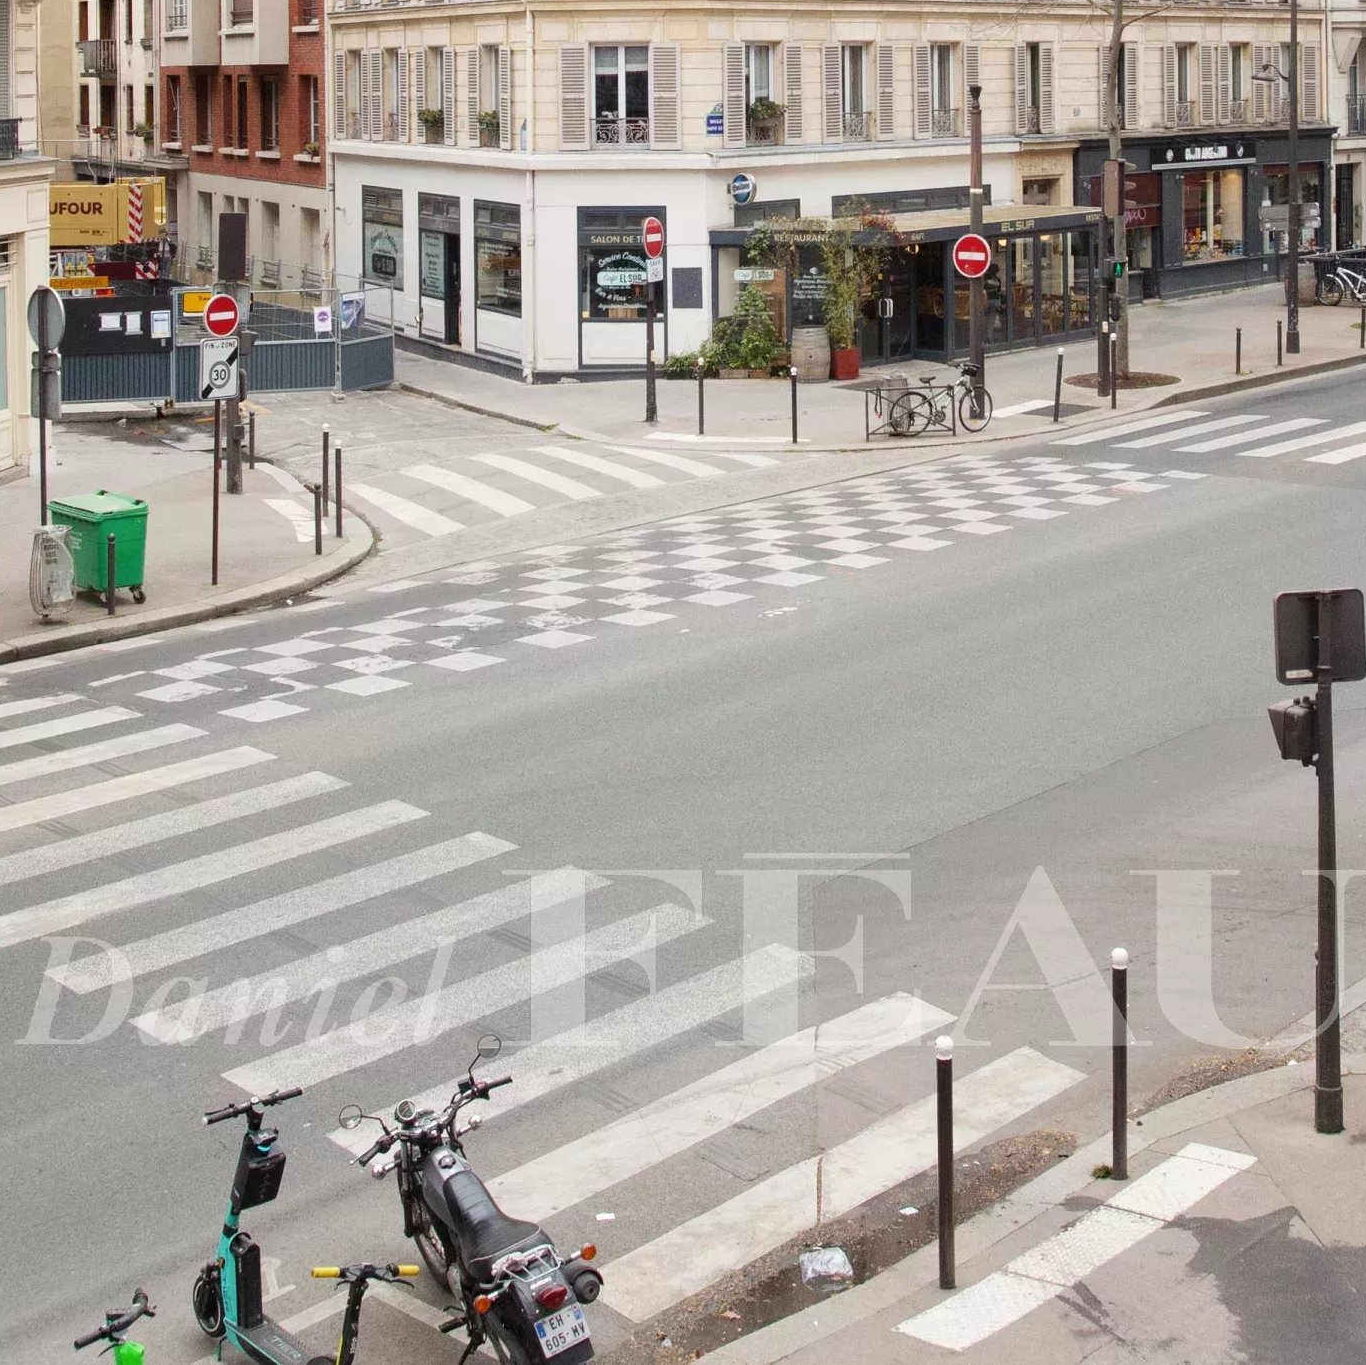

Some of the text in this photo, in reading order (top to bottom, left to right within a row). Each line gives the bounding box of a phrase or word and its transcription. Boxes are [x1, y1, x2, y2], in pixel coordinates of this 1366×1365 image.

[49, 202, 103, 215] UFOUR
[1001, 219, 1035, 232] EL SUR
[591, 235, 620, 243] SALON
[50, 277, 104, 288] CEPTIONNEL
[221, 341, 236, 349] ZONE
[213, 369, 227, 381] 30
